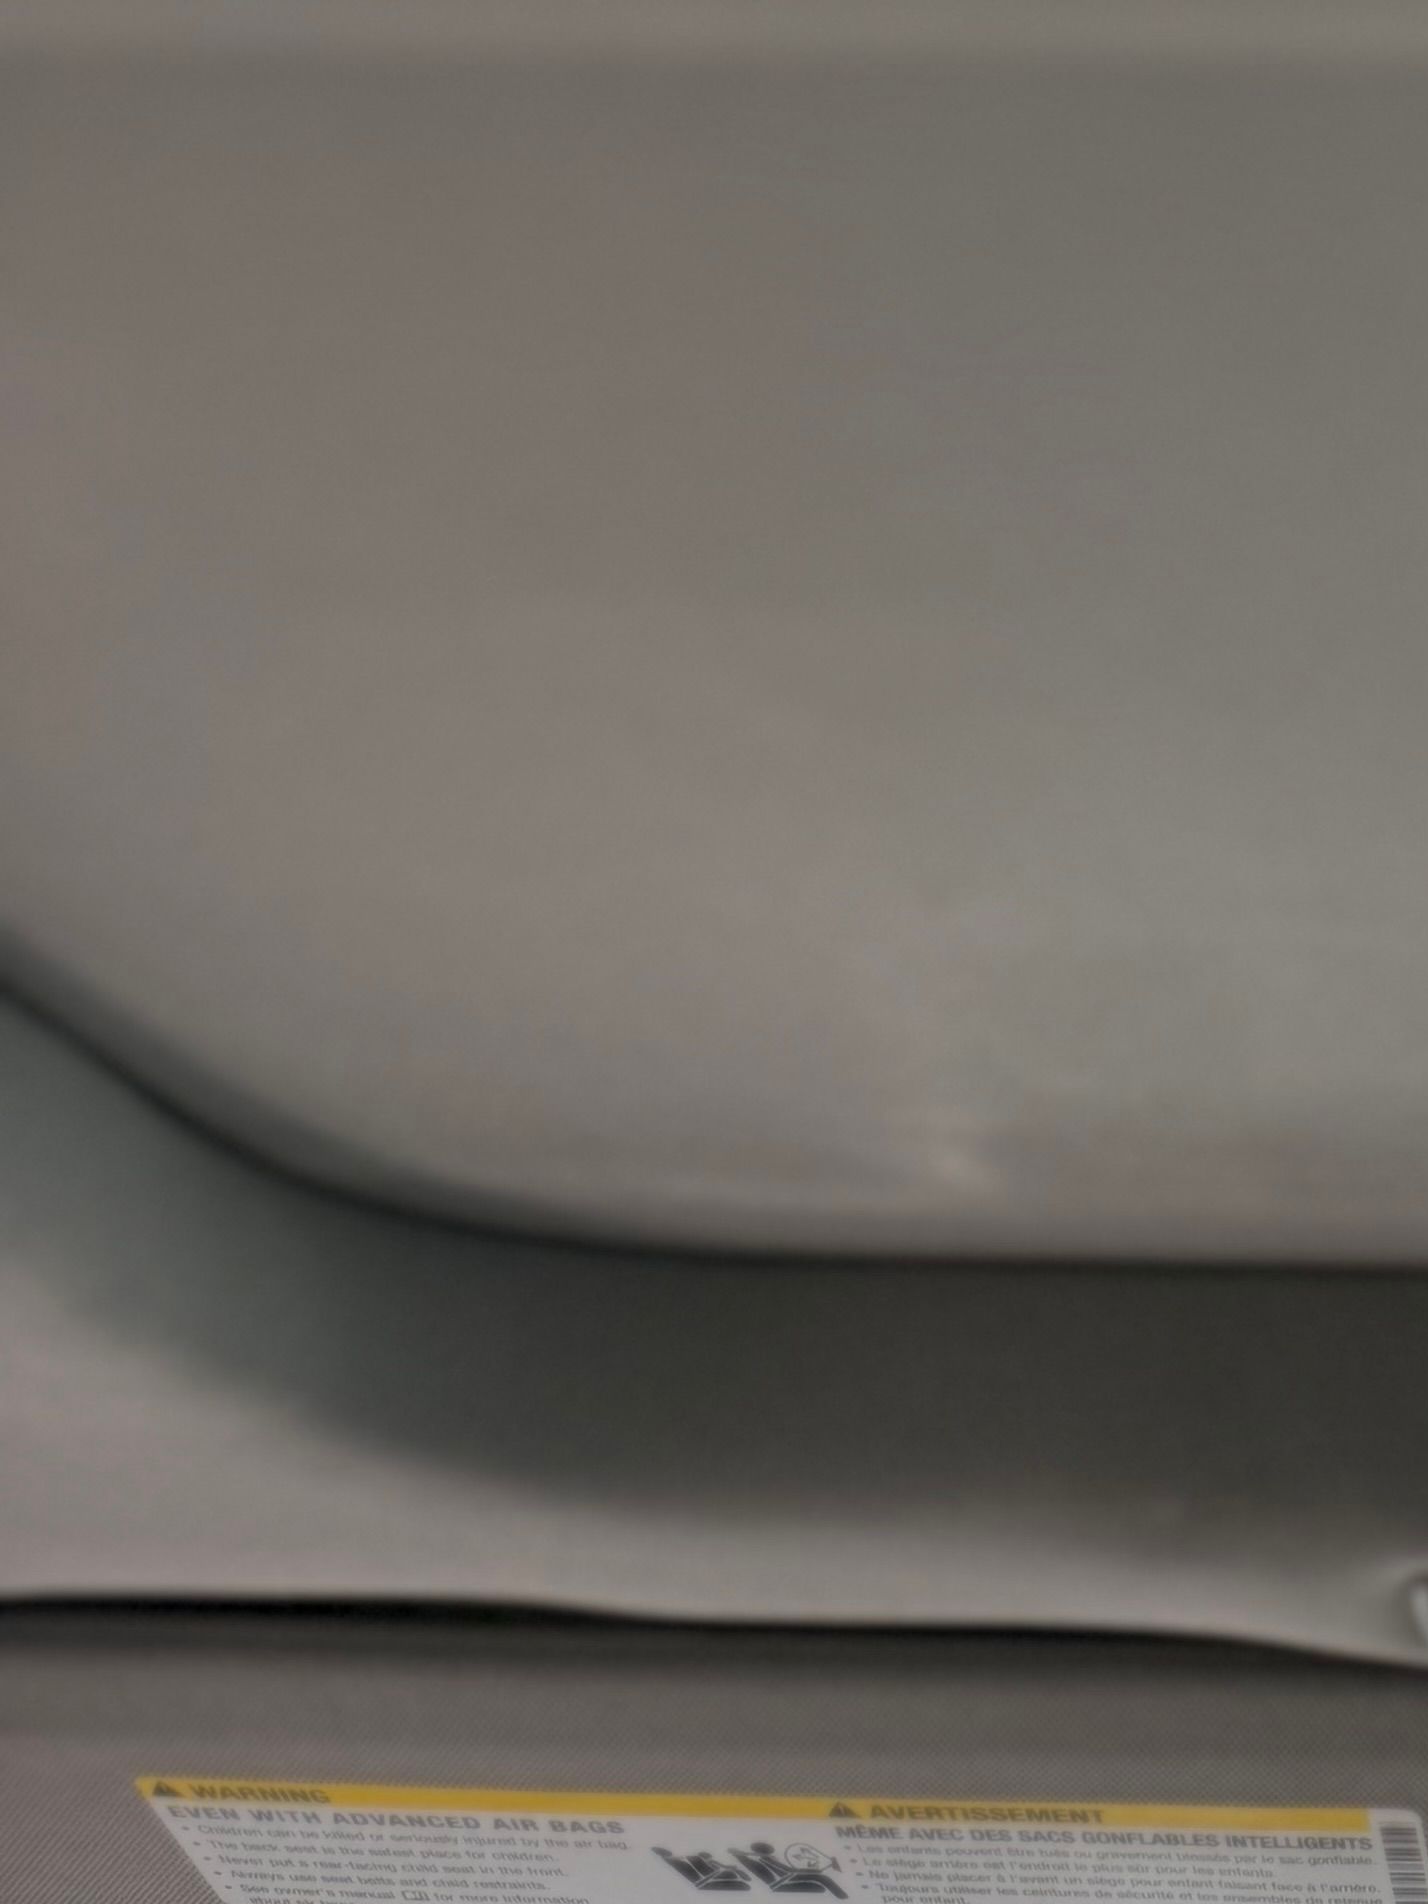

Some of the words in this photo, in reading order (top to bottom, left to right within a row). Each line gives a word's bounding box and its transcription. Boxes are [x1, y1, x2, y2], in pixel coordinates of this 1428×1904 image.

[188, 1784, 331, 1804] WARNING
[167, 1806, 240, 1820] EVEN
[248, 1808, 322, 1824] WITH
[333, 1811, 480, 1829] ADVANCED
[494, 1818, 539, 1831] AIR
[549, 1820, 625, 1834] BAGS
[870, 1804, 1104, 1823] AVERTISSEMENT
[835, 1824, 903, 1840] MÊME
[909, 1828, 965, 1842] AVEC
[970, 1829, 1013, 1842] DES
[1018, 1830, 1075, 1843] SACS
[1081, 1831, 1220, 1847] GONFLABLES
[1226, 1834, 1373, 1851] INTELLIGENTS
